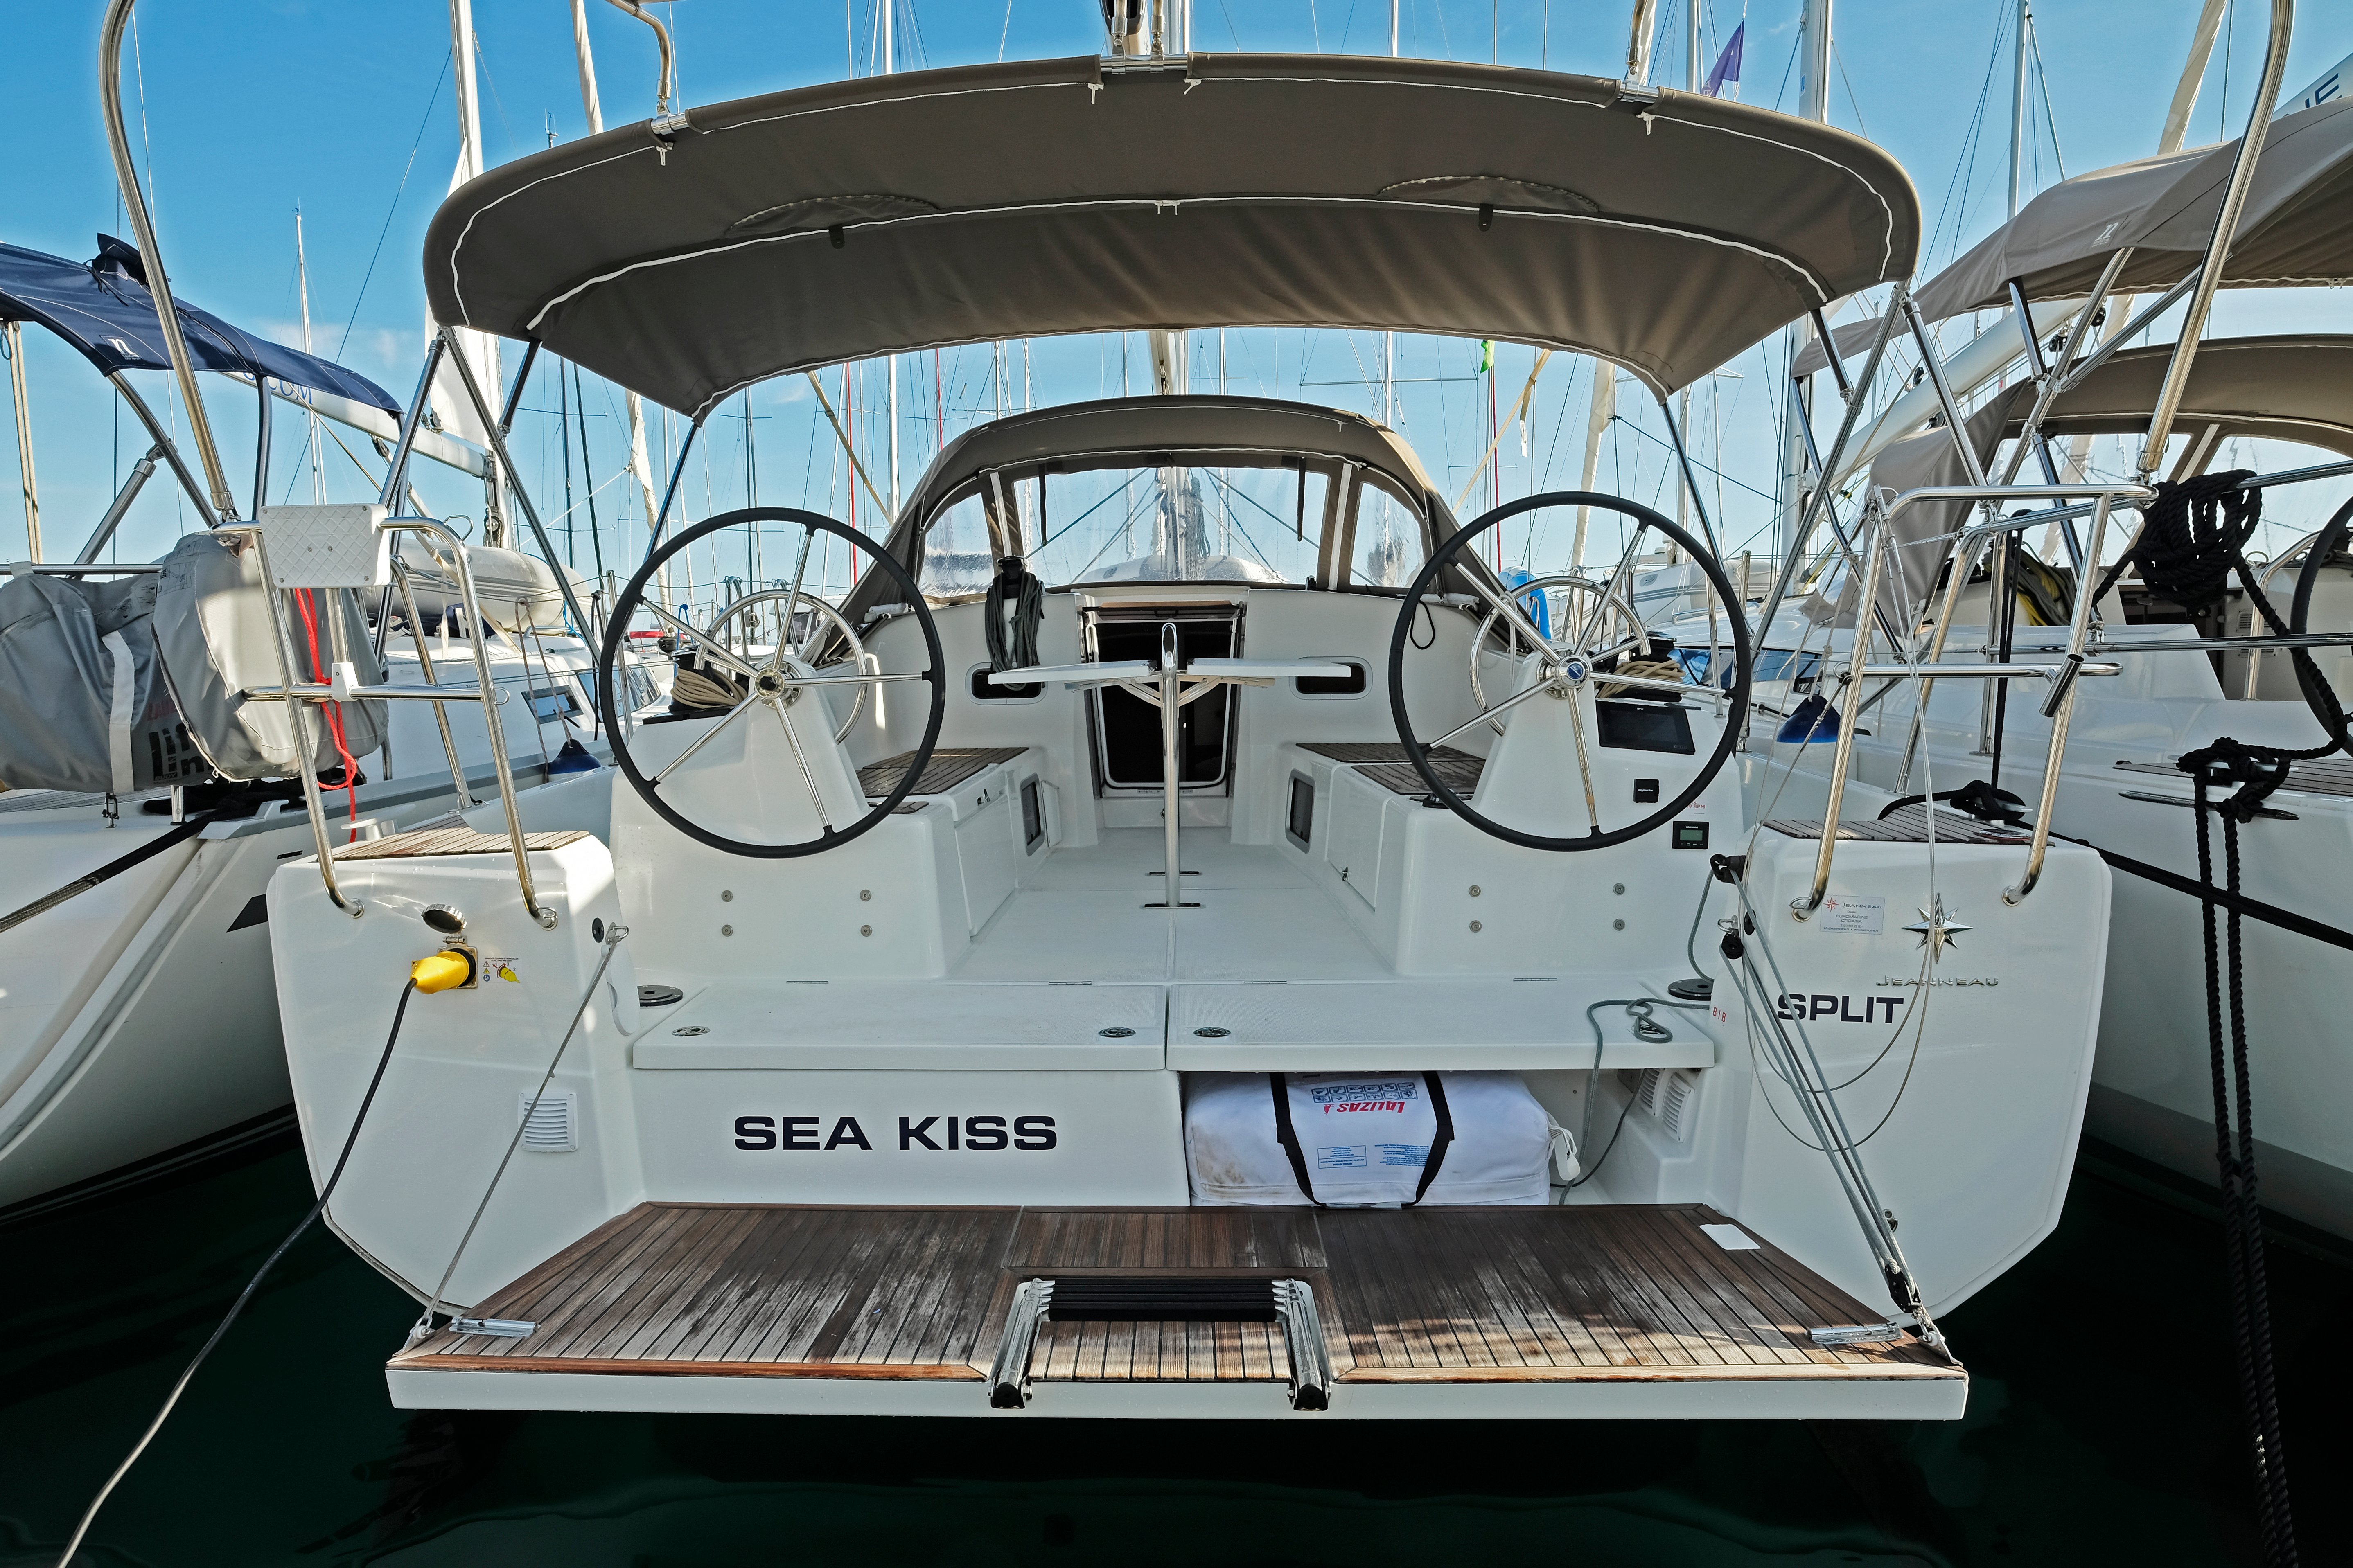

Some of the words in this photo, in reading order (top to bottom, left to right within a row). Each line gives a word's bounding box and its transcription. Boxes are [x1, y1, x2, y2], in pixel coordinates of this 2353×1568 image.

[1876, 975, 1999, 987] JEANNEAU
[1777, 994, 1904, 1024] SPLIT
[1336, 1101, 1405, 1113] LALIZAS
[734, 1115, 873, 1151] SEA
[899, 1115, 1058, 1151] KISS
